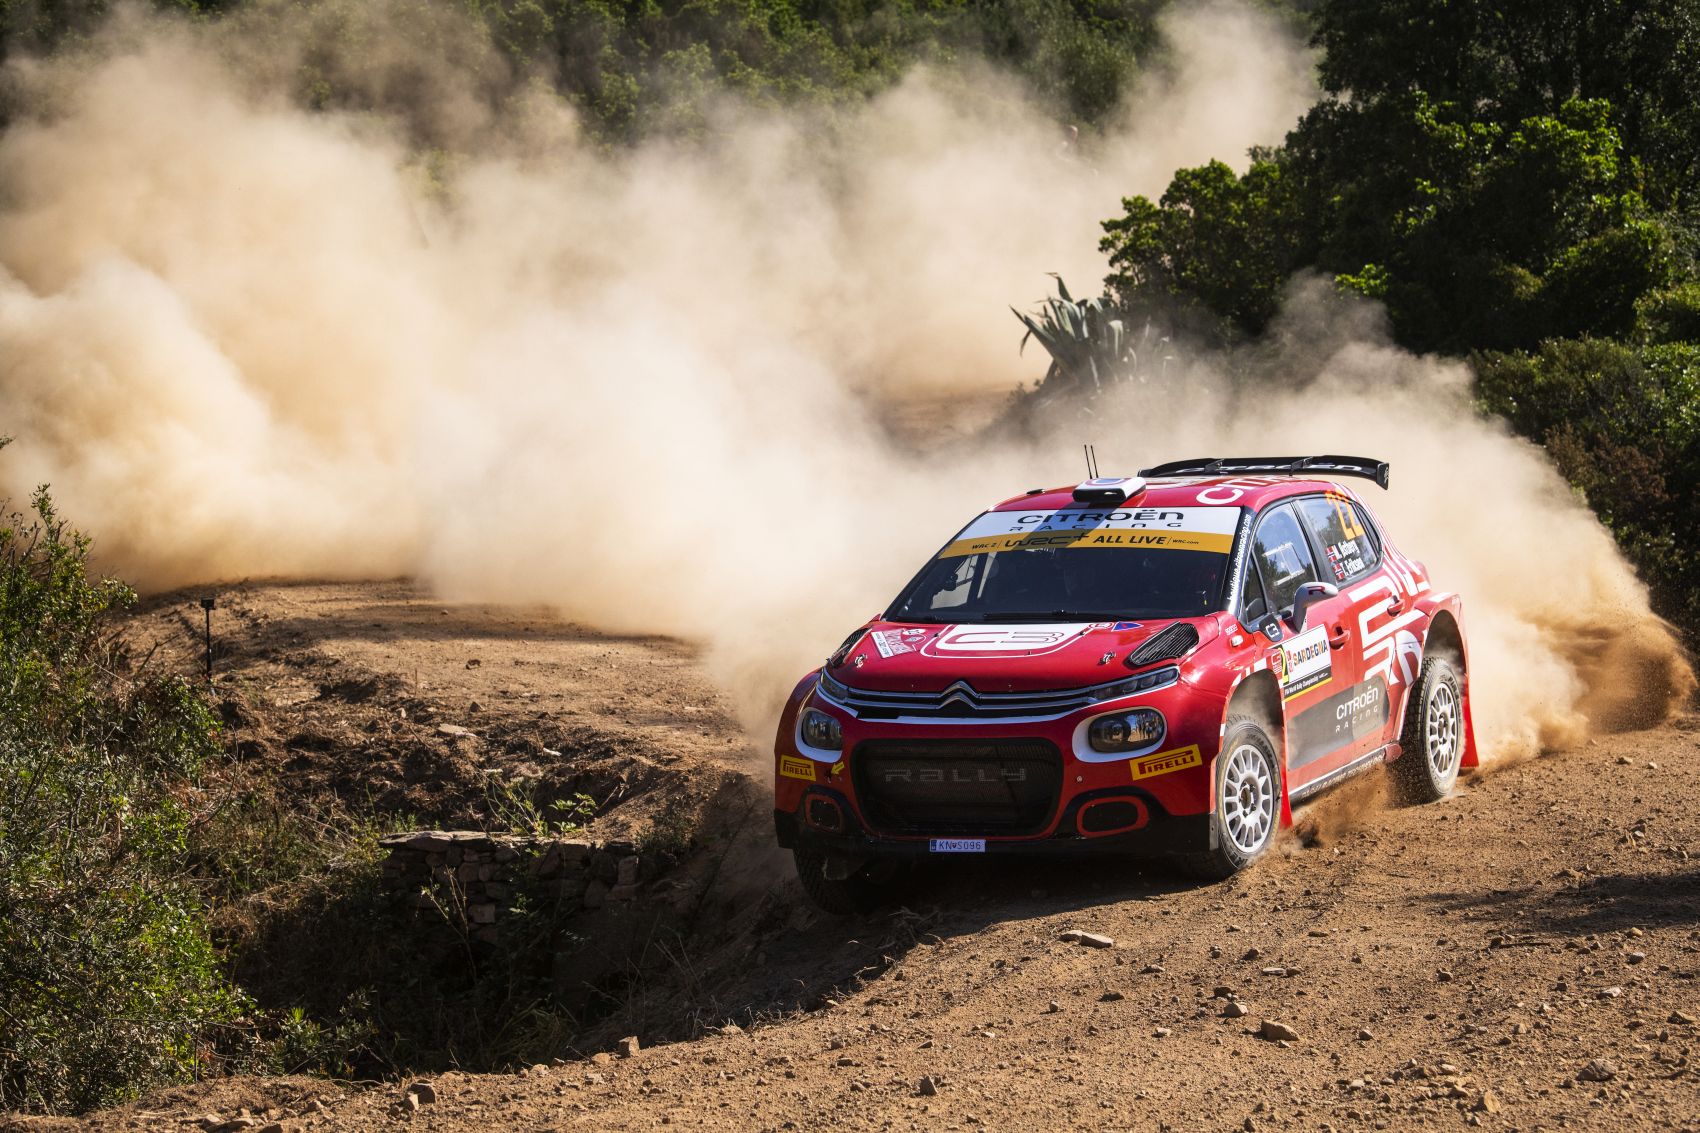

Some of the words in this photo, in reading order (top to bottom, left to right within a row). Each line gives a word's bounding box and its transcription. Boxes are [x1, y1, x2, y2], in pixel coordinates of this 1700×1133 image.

[1017, 509, 1184, 524] CITROËN
[1009, 522, 1182, 532] RACING
[1093, 535, 1123, 544] ALL
[1129, 535, 1167, 545] LIVE
[1293, 639, 1329, 667] SARDEGNA
[1336, 685, 1379, 720] CITROËN
[783, 759, 812, 777] PIRELLI
[1138, 749, 1195, 776] PIRELLI
